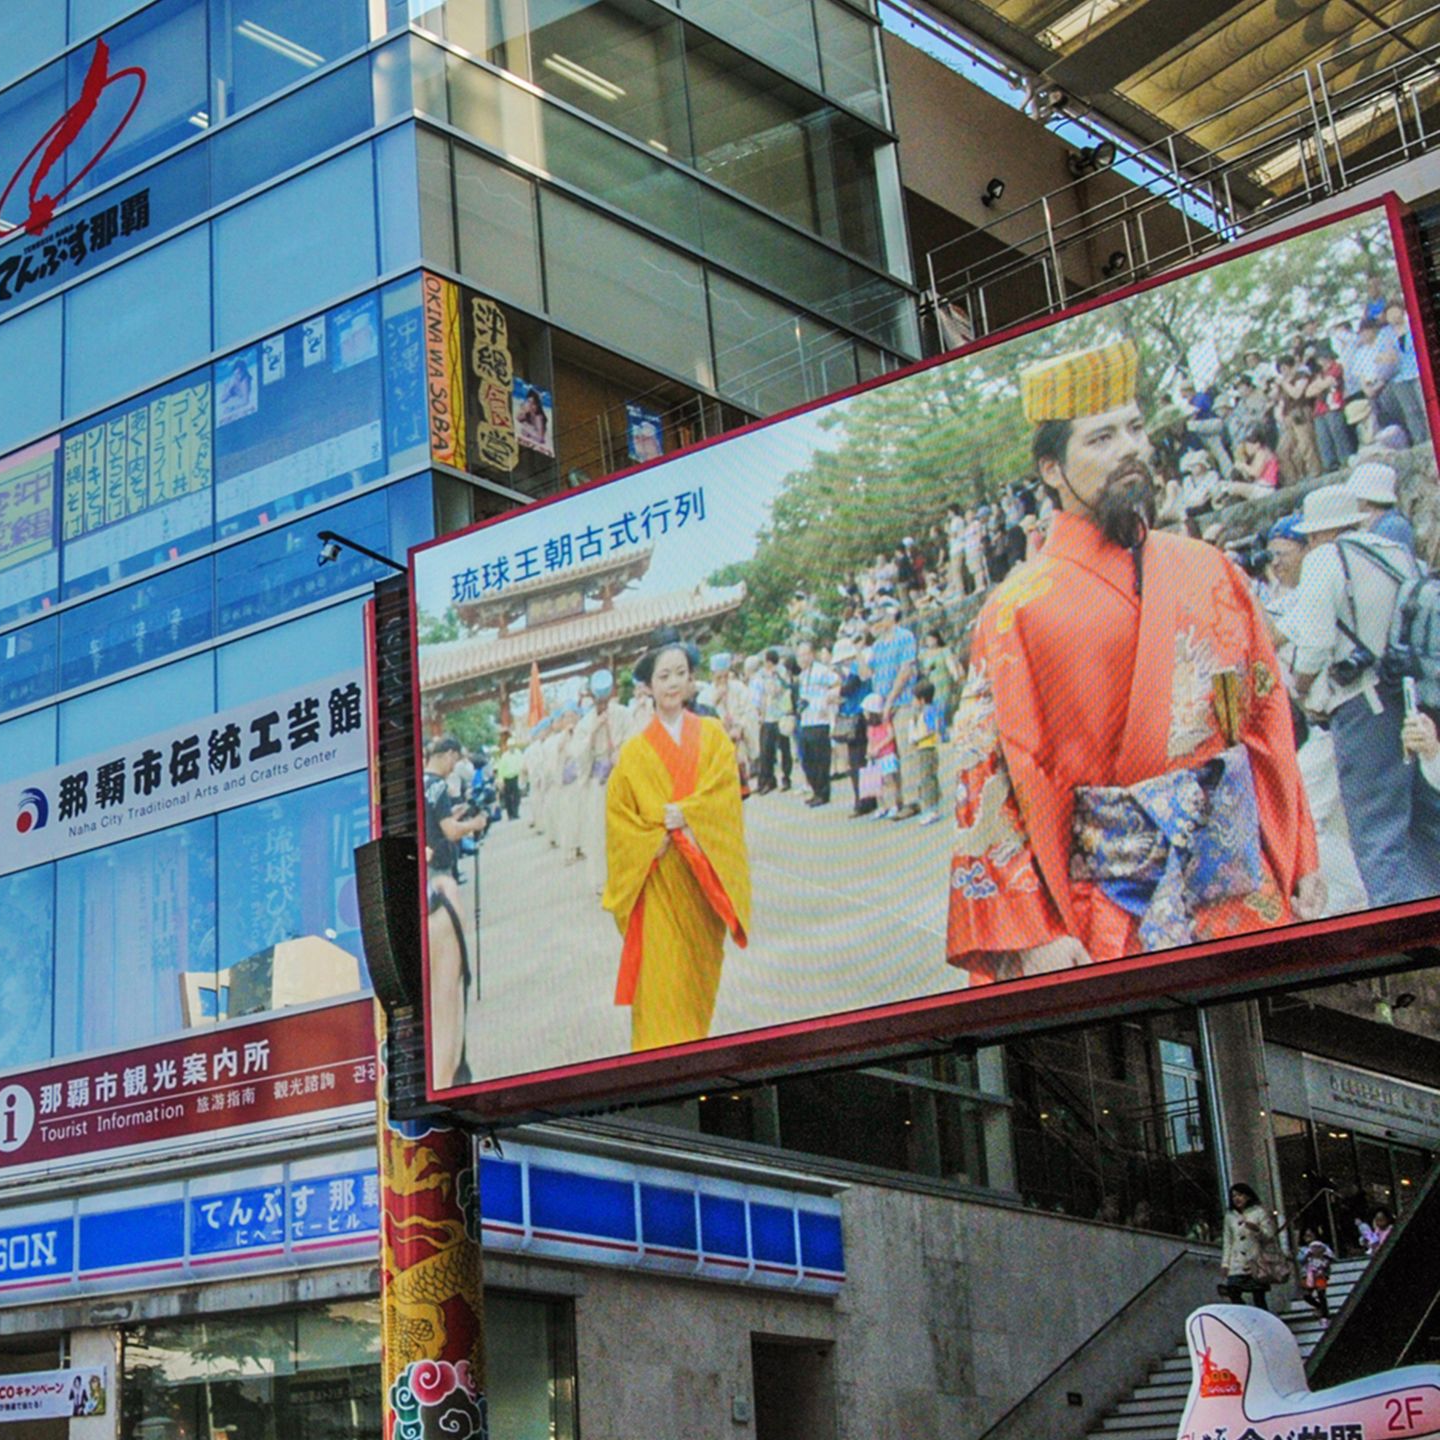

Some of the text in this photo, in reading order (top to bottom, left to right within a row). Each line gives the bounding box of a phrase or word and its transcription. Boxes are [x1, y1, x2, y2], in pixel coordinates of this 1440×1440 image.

[430, 383, 450, 451] SOBA
[154, 400, 167, 501] タコライス
[451, 487, 707, 602] 琉球王朝古式行列
[58, 682, 363, 821] 那覇市伝統工芸館
[68, 747, 338, 838] Naha City Traditional Arts and Crafts Center
[39, 1040, 270, 1114] 那覇市観光案内所
[196, 1087, 256, 1114] 旅游指南
[273, 1072, 335, 1100] 觀光諮詢
[41, 1101, 184, 1142] Tourist Information
[201, 1174, 378, 1230] てんぶす那覇
[236, 1213, 360, 1246] にへーでービル
[1384, 1397, 1424, 1431] 2F
